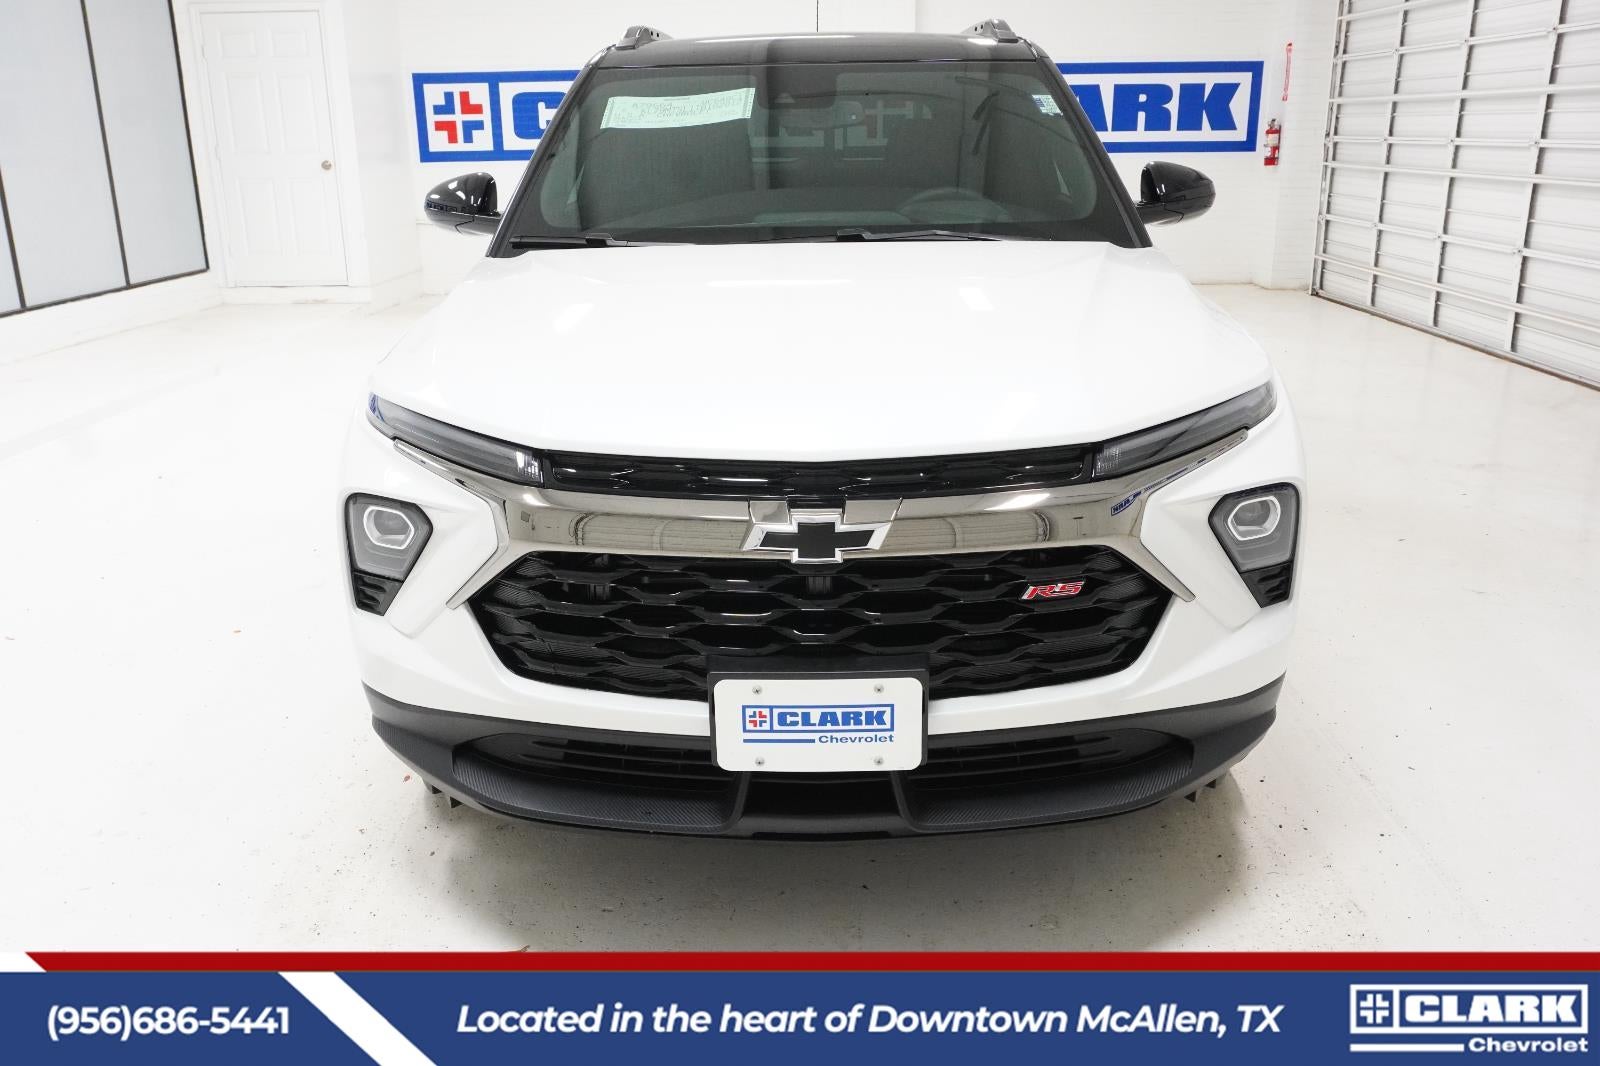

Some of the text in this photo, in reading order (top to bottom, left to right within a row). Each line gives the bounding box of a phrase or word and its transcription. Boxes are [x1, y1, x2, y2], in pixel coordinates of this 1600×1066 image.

[1021, 581, 1085, 600] RS
[777, 710, 887, 727] CLARK
[818, 734, 894, 744] Chevrolet
